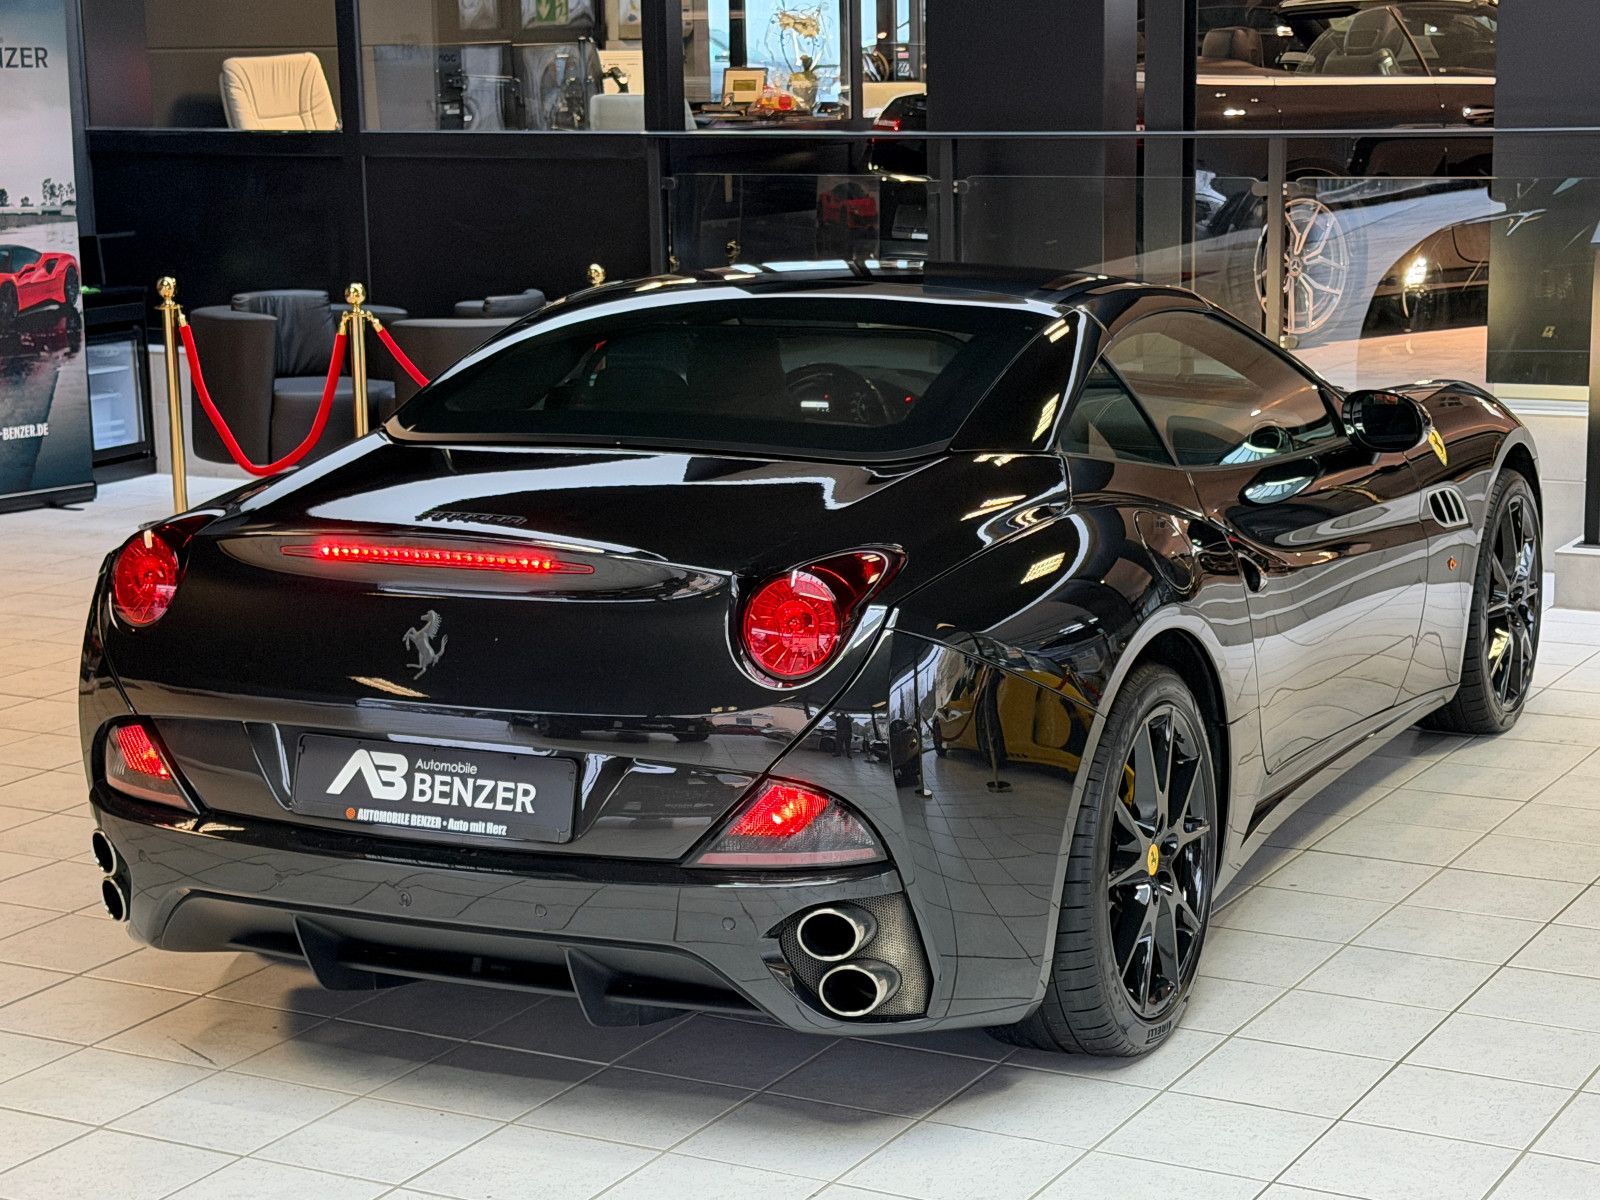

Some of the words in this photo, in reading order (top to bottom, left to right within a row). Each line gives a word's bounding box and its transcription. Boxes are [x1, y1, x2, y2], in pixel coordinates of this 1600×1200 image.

[414, 758, 479, 775] Automobile
[411, 772, 537, 814] BENZER
[357, 807, 410, 826] AUTOMOBILE
[410, 813, 442, 829] BENZER
[447, 817, 469, 832] Auto
[469, 820, 486, 833] mit
[486, 821, 508, 836] Herz
